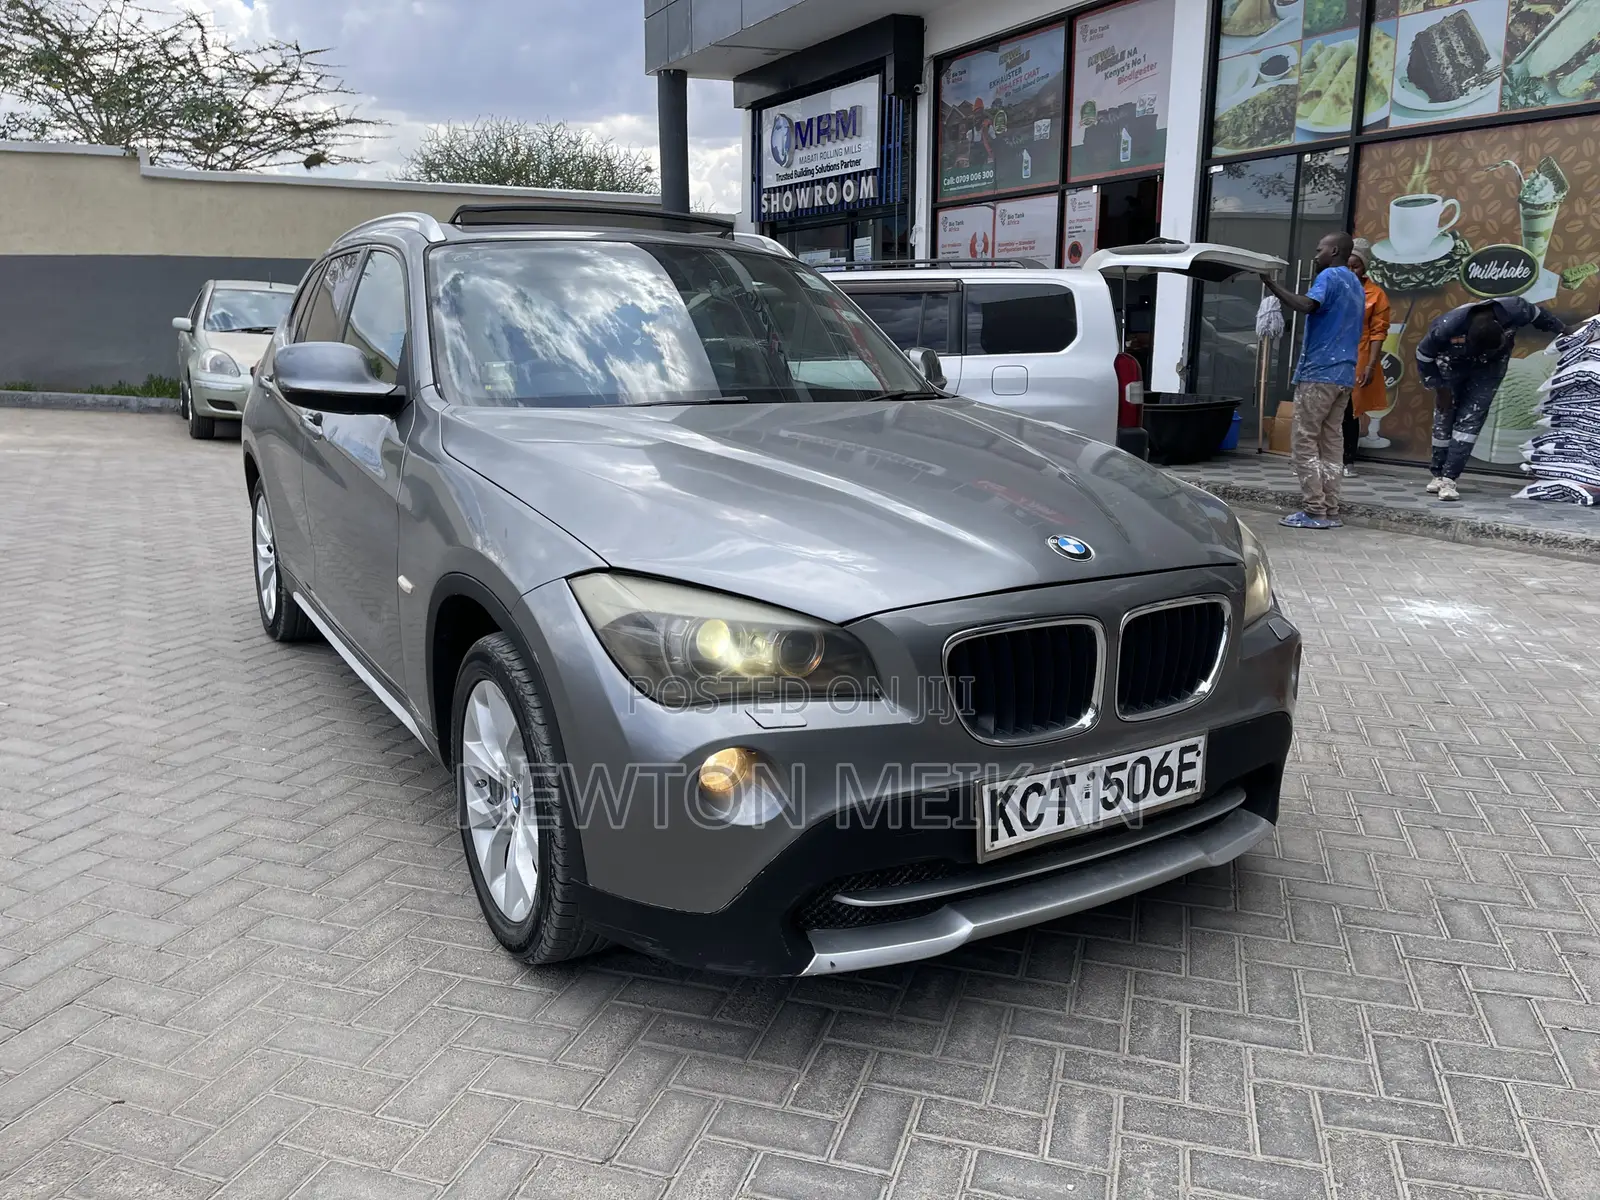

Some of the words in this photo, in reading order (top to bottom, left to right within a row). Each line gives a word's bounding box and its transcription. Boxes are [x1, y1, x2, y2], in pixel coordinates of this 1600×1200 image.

[1127, 47, 1138, 59] NA
[1023, 67, 1040, 81] CHAT
[1104, 62, 1130, 80] Kenya's
[1131, 58, 1142, 68] No
[1143, 53, 1147, 63] 1
[1117, 62, 1158, 86] Biodigester
[989, 67, 1023, 90] EXHAUSTER
[795, 105, 861, 150] MRM
[799, 153, 819, 164] MABATI
[819, 148, 843, 159] ROLLING
[844, 144, 862, 155] MILLS
[776, 171, 793, 182] Trusted
[794, 167, 815, 178] Building
[815, 161, 840, 174] Solutions
[840, 158, 862, 169] Partner
[943, 176, 956, 186] Call:
[982, 169, 994, 180] 300
[761, 176, 877, 213] SHOWROOM
[1468, 259, 1532, 281] Milkshake
[988, 775, 1076, 844] KCT
[1098, 743, 1200, 812] 506E
